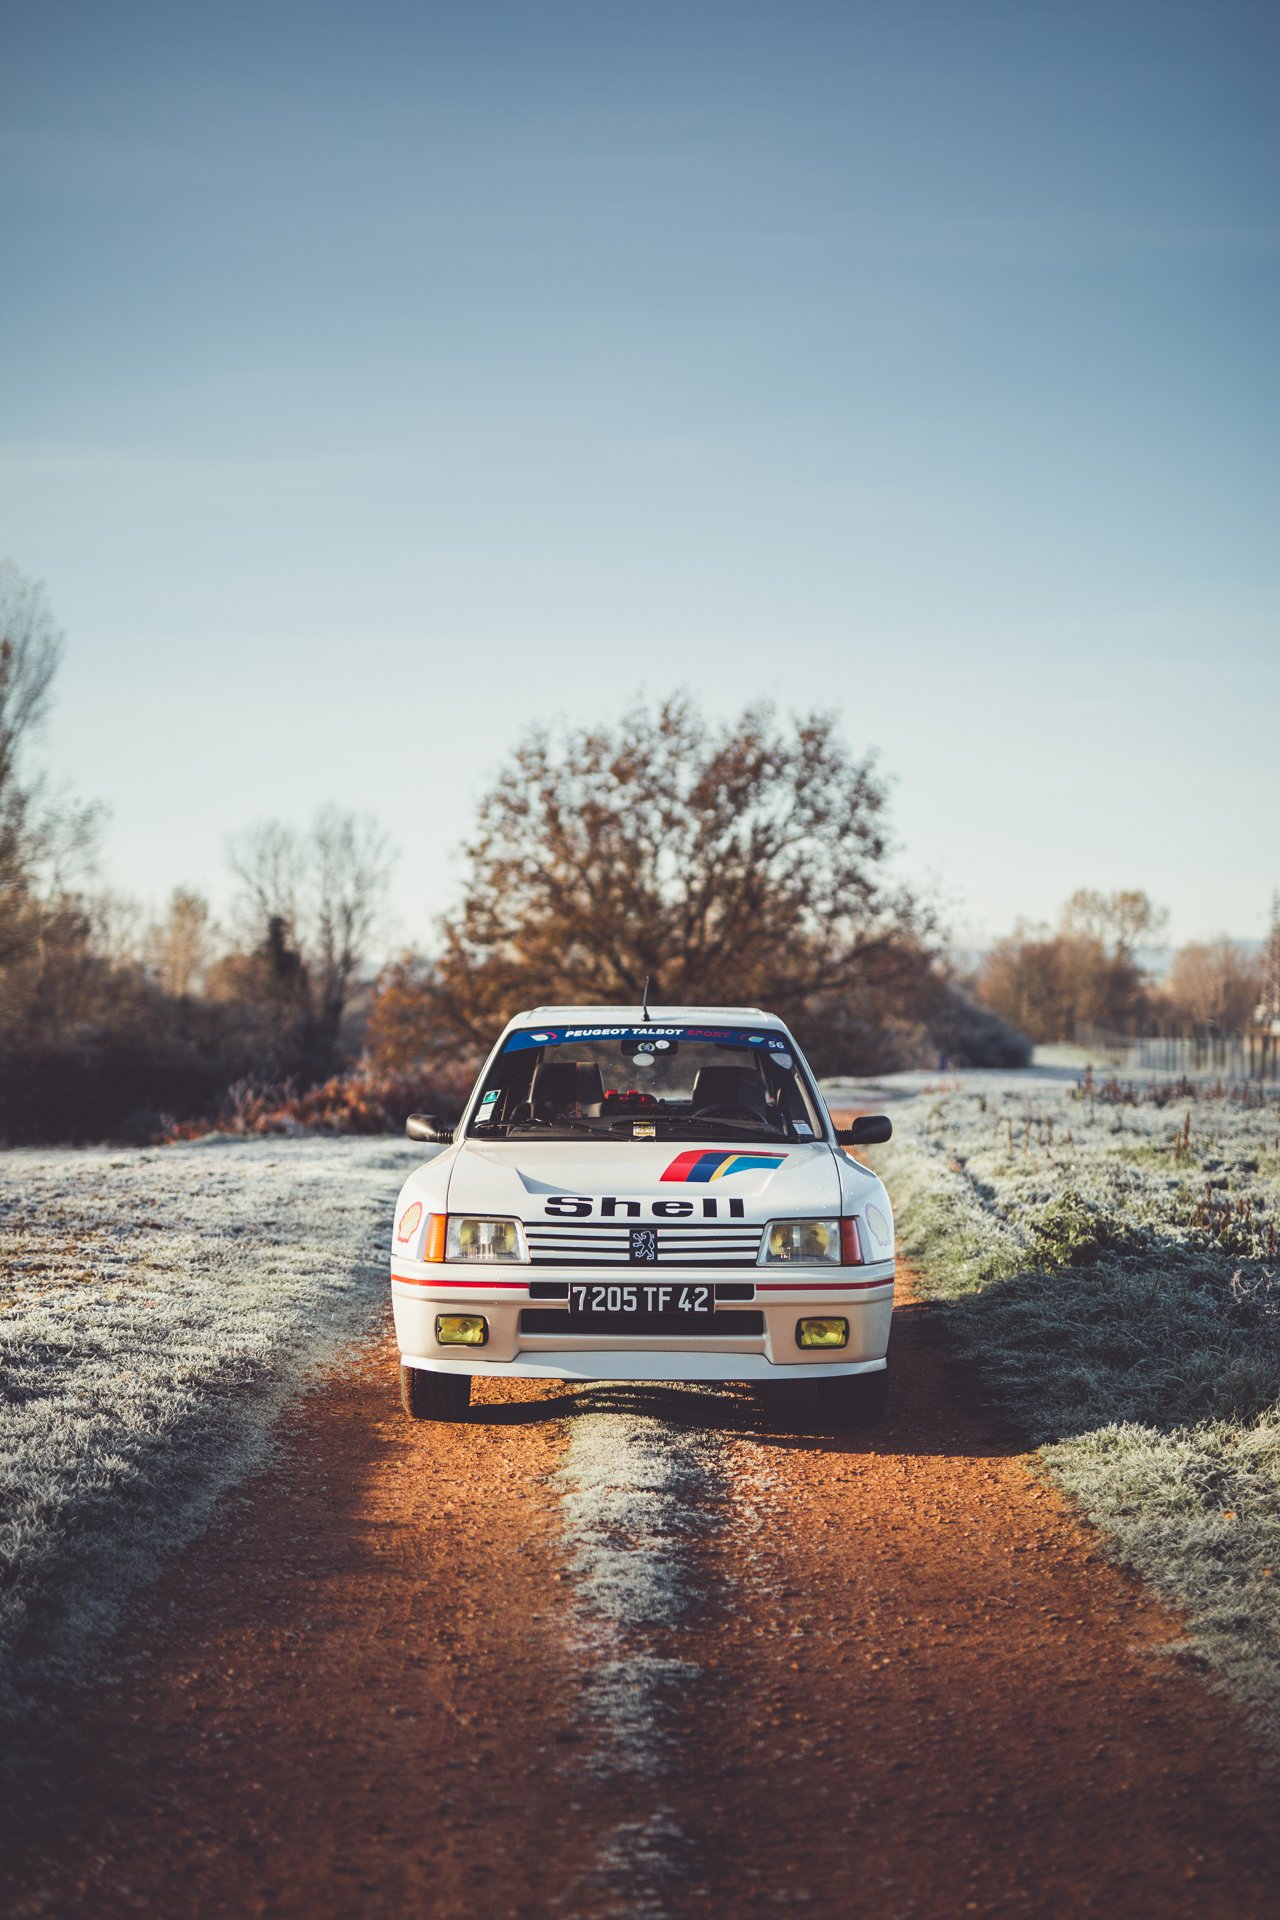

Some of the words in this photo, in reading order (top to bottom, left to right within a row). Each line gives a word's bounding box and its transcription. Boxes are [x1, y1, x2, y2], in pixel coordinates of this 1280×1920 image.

[565, 1028, 629, 1037] PEUGEOT
[632, 1028, 684, 1036] TALBOT
[687, 1029, 731, 1038] SPORT
[768, 1040, 785, 1049] 56
[544, 1196, 745, 1218] Shell
[572, 1286, 637, 1312] 7205
[643, 1286, 672, 1312] TF
[678, 1287, 709, 1312] 42
